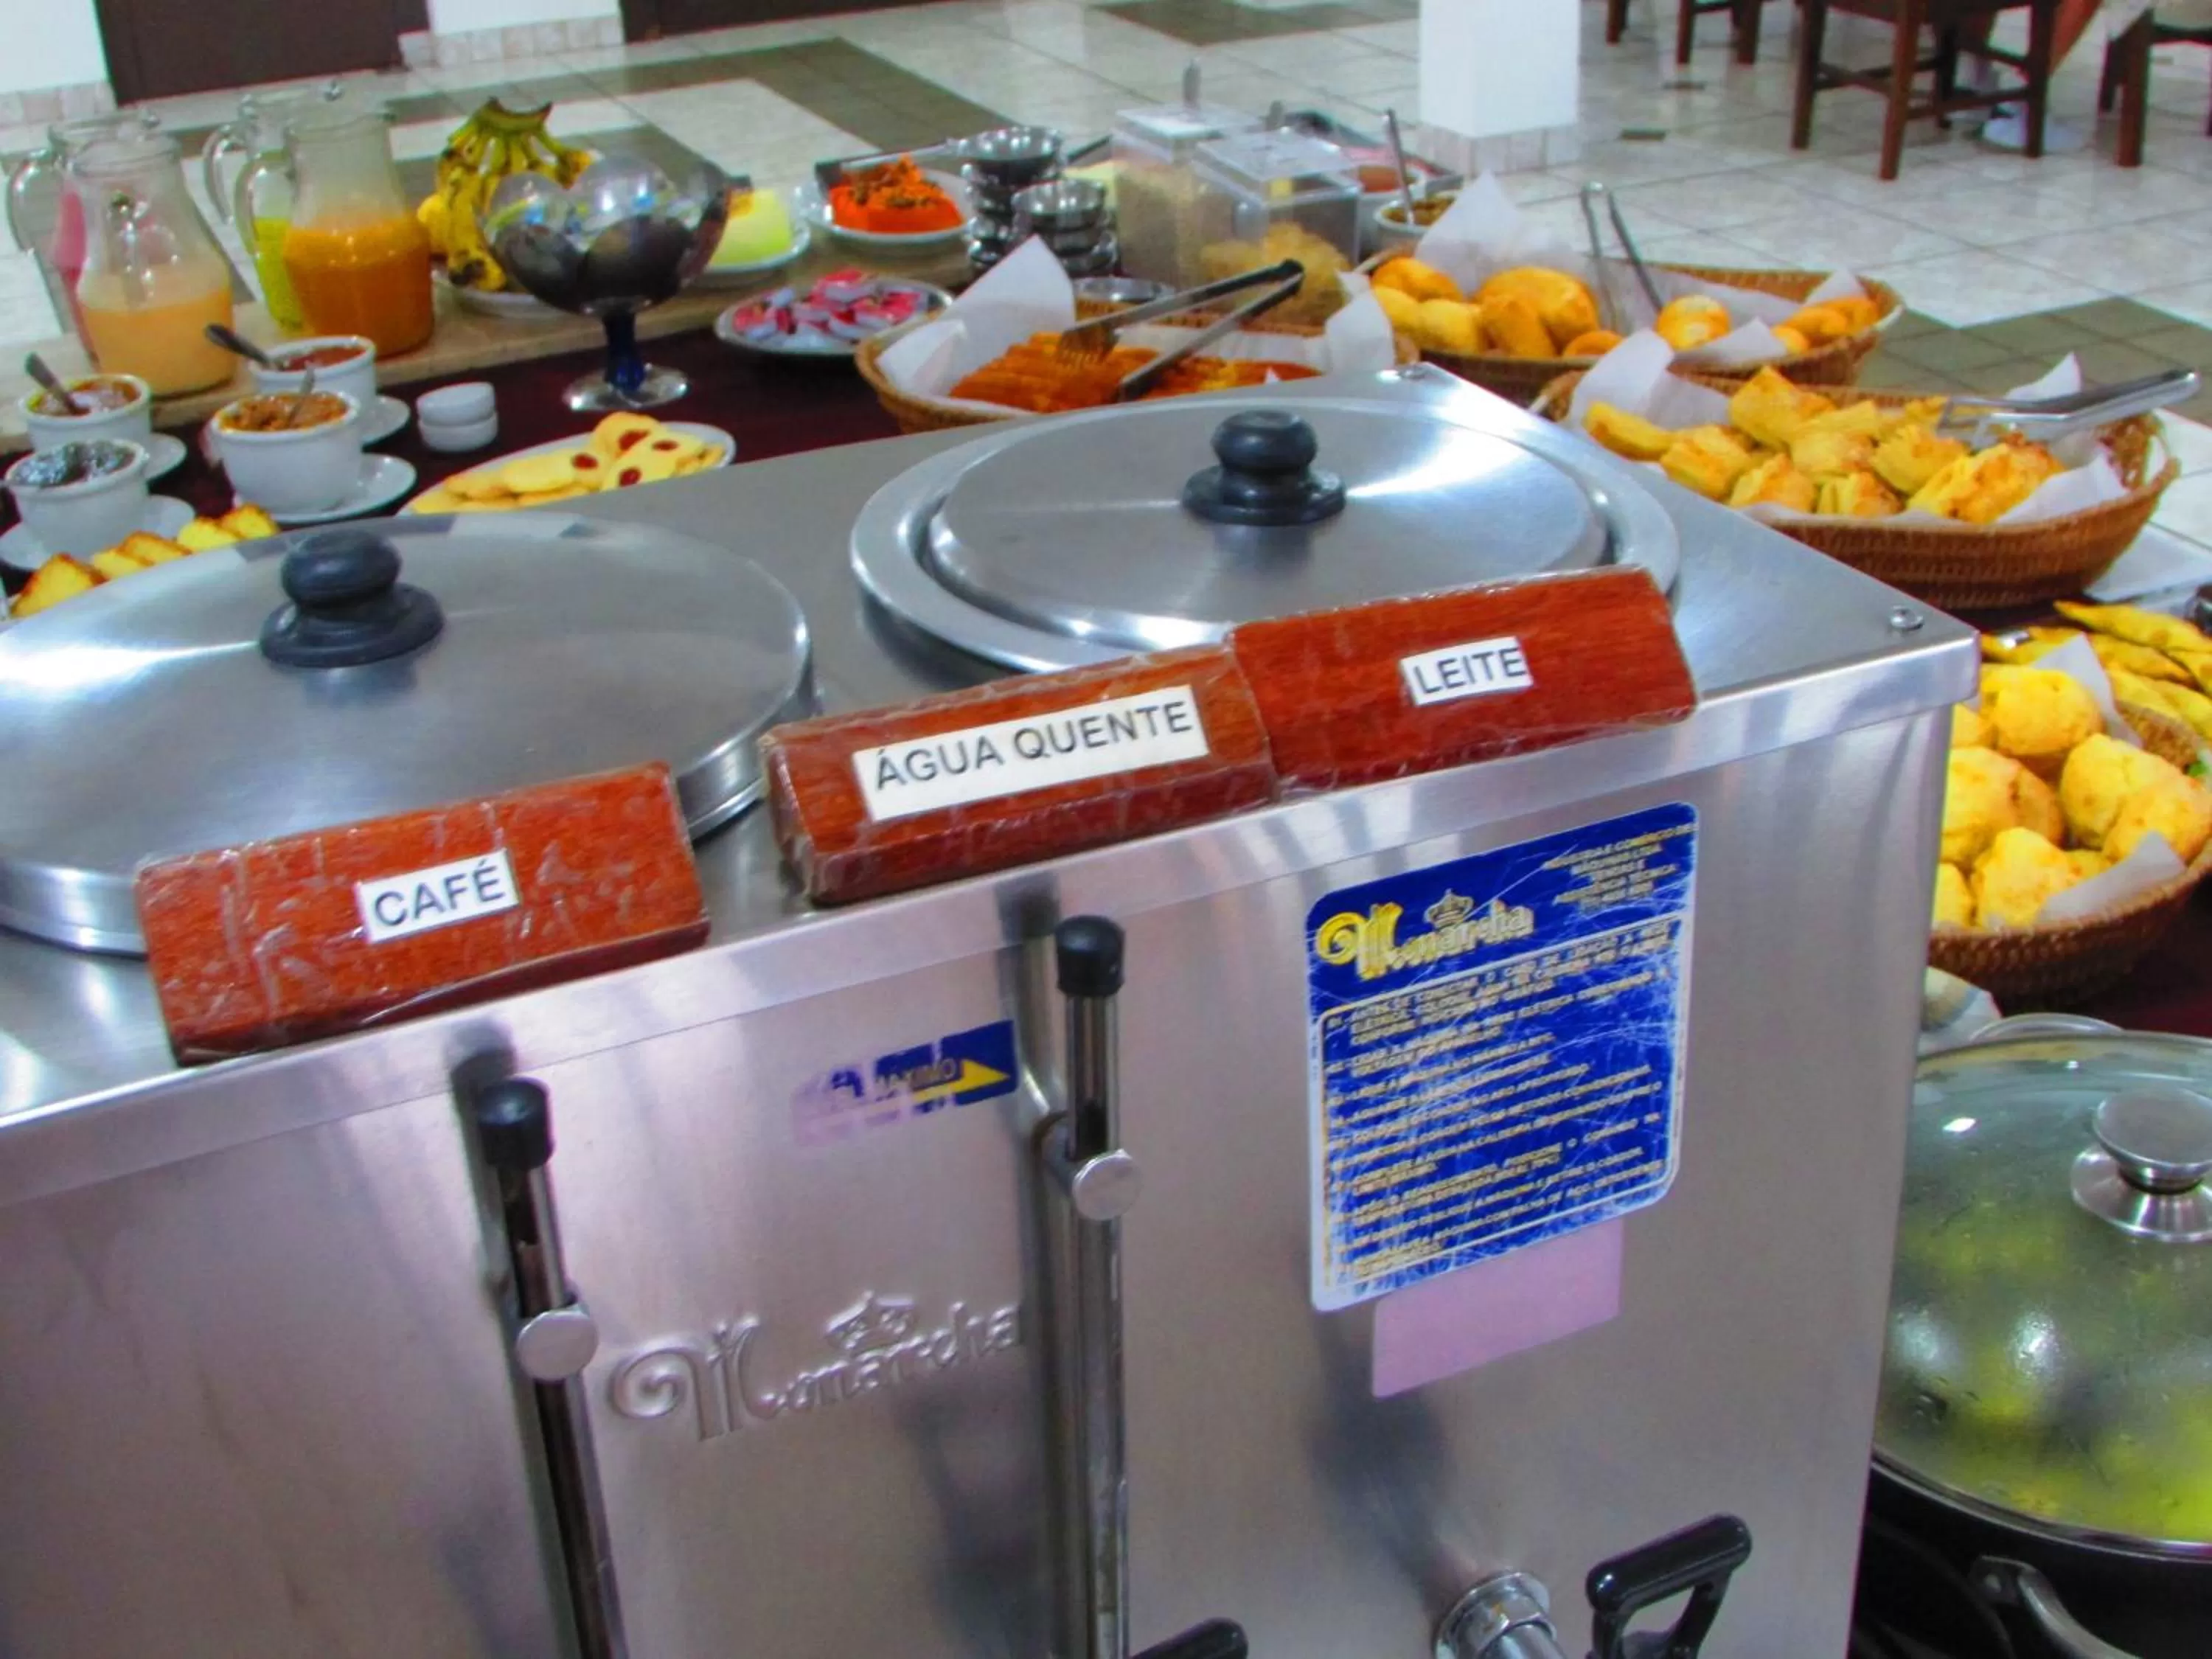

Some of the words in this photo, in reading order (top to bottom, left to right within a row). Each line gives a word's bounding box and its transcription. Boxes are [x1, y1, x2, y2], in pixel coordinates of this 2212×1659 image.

[1413, 647, 1527, 694] LEITE
[875, 735, 1004, 790] ÁGUA
[1013, 701, 1193, 760] QUENTE
[374, 858, 507, 927] CAFÉ
